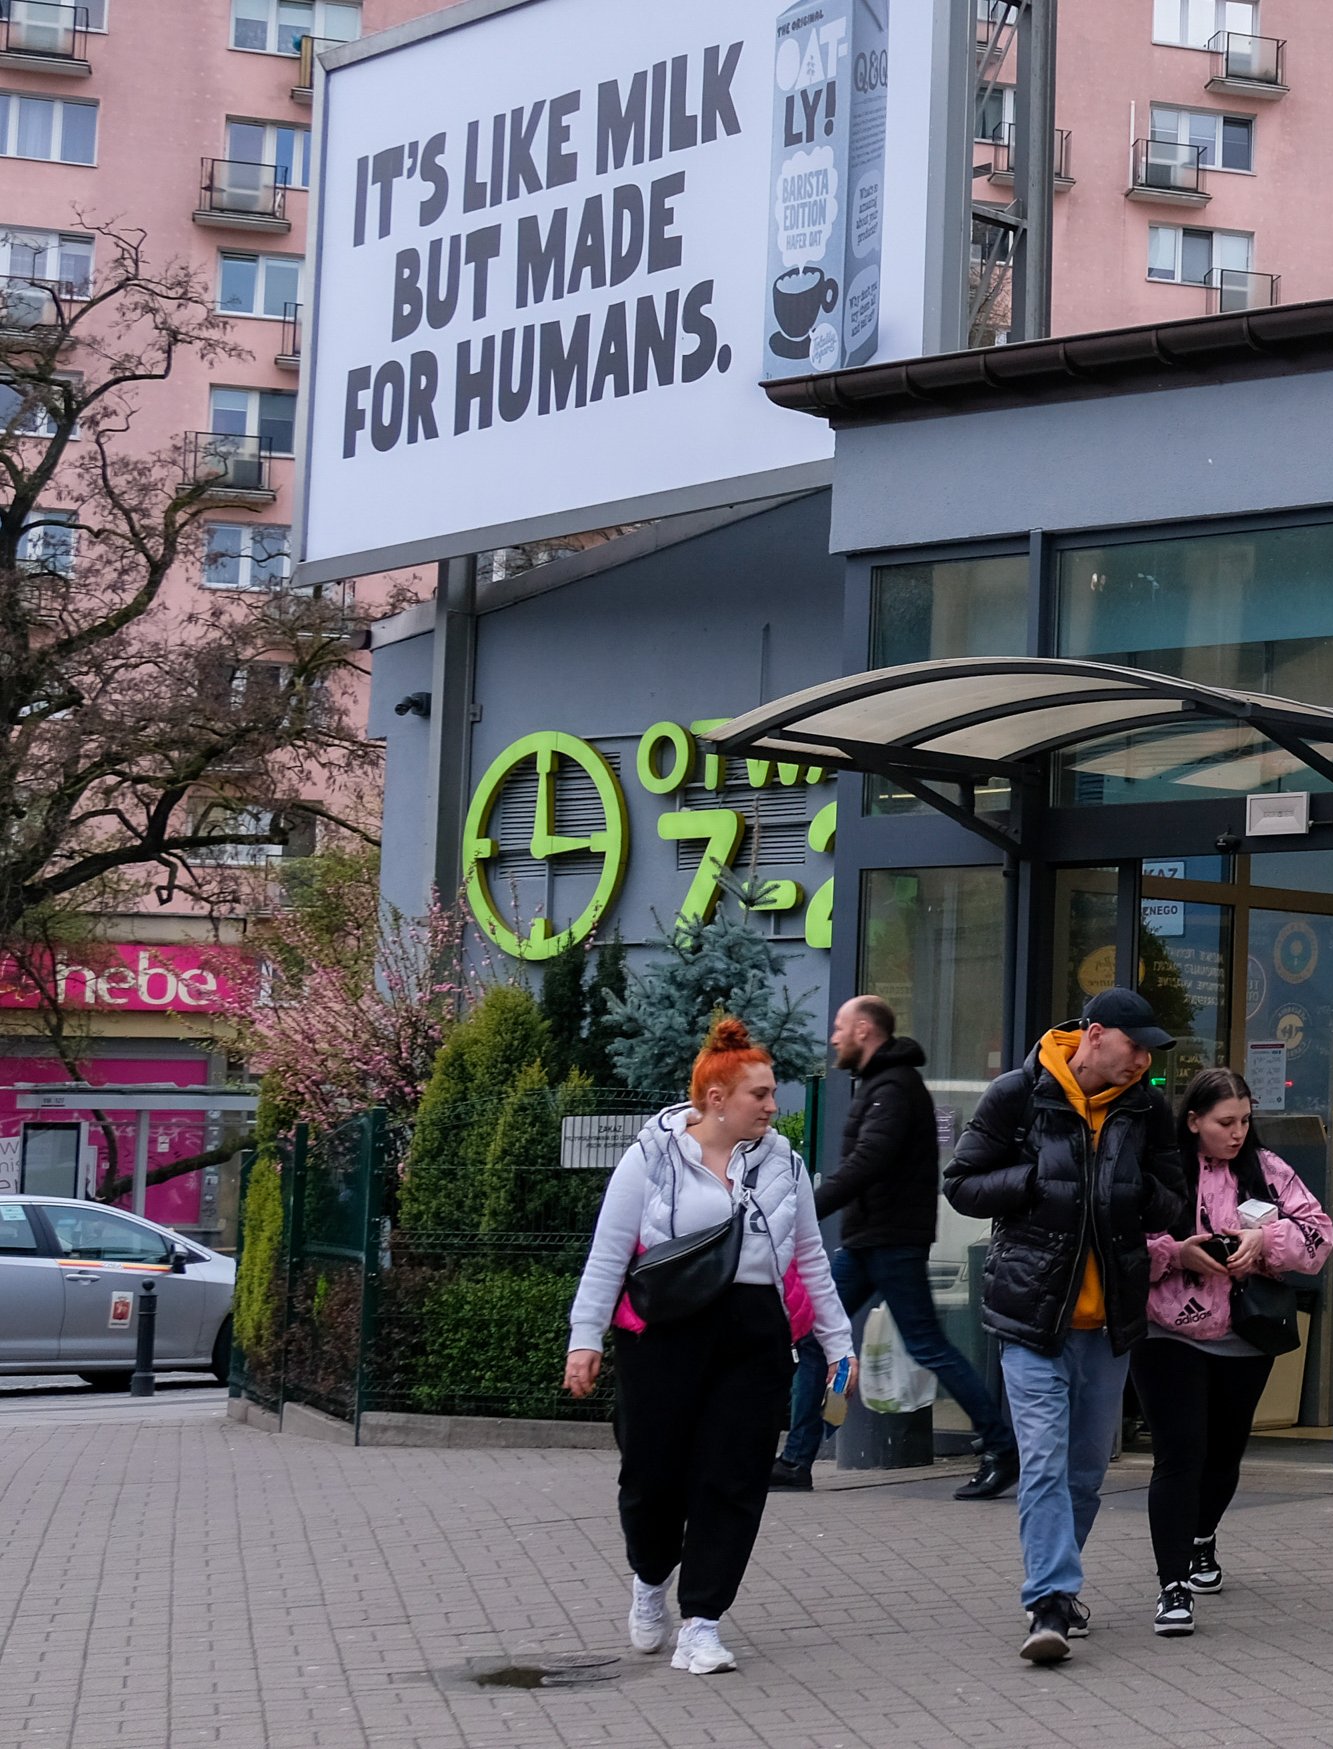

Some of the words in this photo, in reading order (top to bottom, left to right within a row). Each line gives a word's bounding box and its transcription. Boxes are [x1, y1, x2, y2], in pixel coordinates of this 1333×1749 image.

[463, 90, 580, 214] LIKE
[596, 41, 745, 176] MILK
[784, 80, 837, 147] LY!
[782, 168, 829, 204] BARISTA
[783, 197, 827, 231] EDITION
[809, 229, 823, 247] OAT
[392, 224, 501, 342] BUT
[516, 170, 686, 308] MADE
[342, 350, 439, 459] FOR
[454, 280, 732, 437] HUMANS.
[1175, 1309, 1212, 1326] adidas
